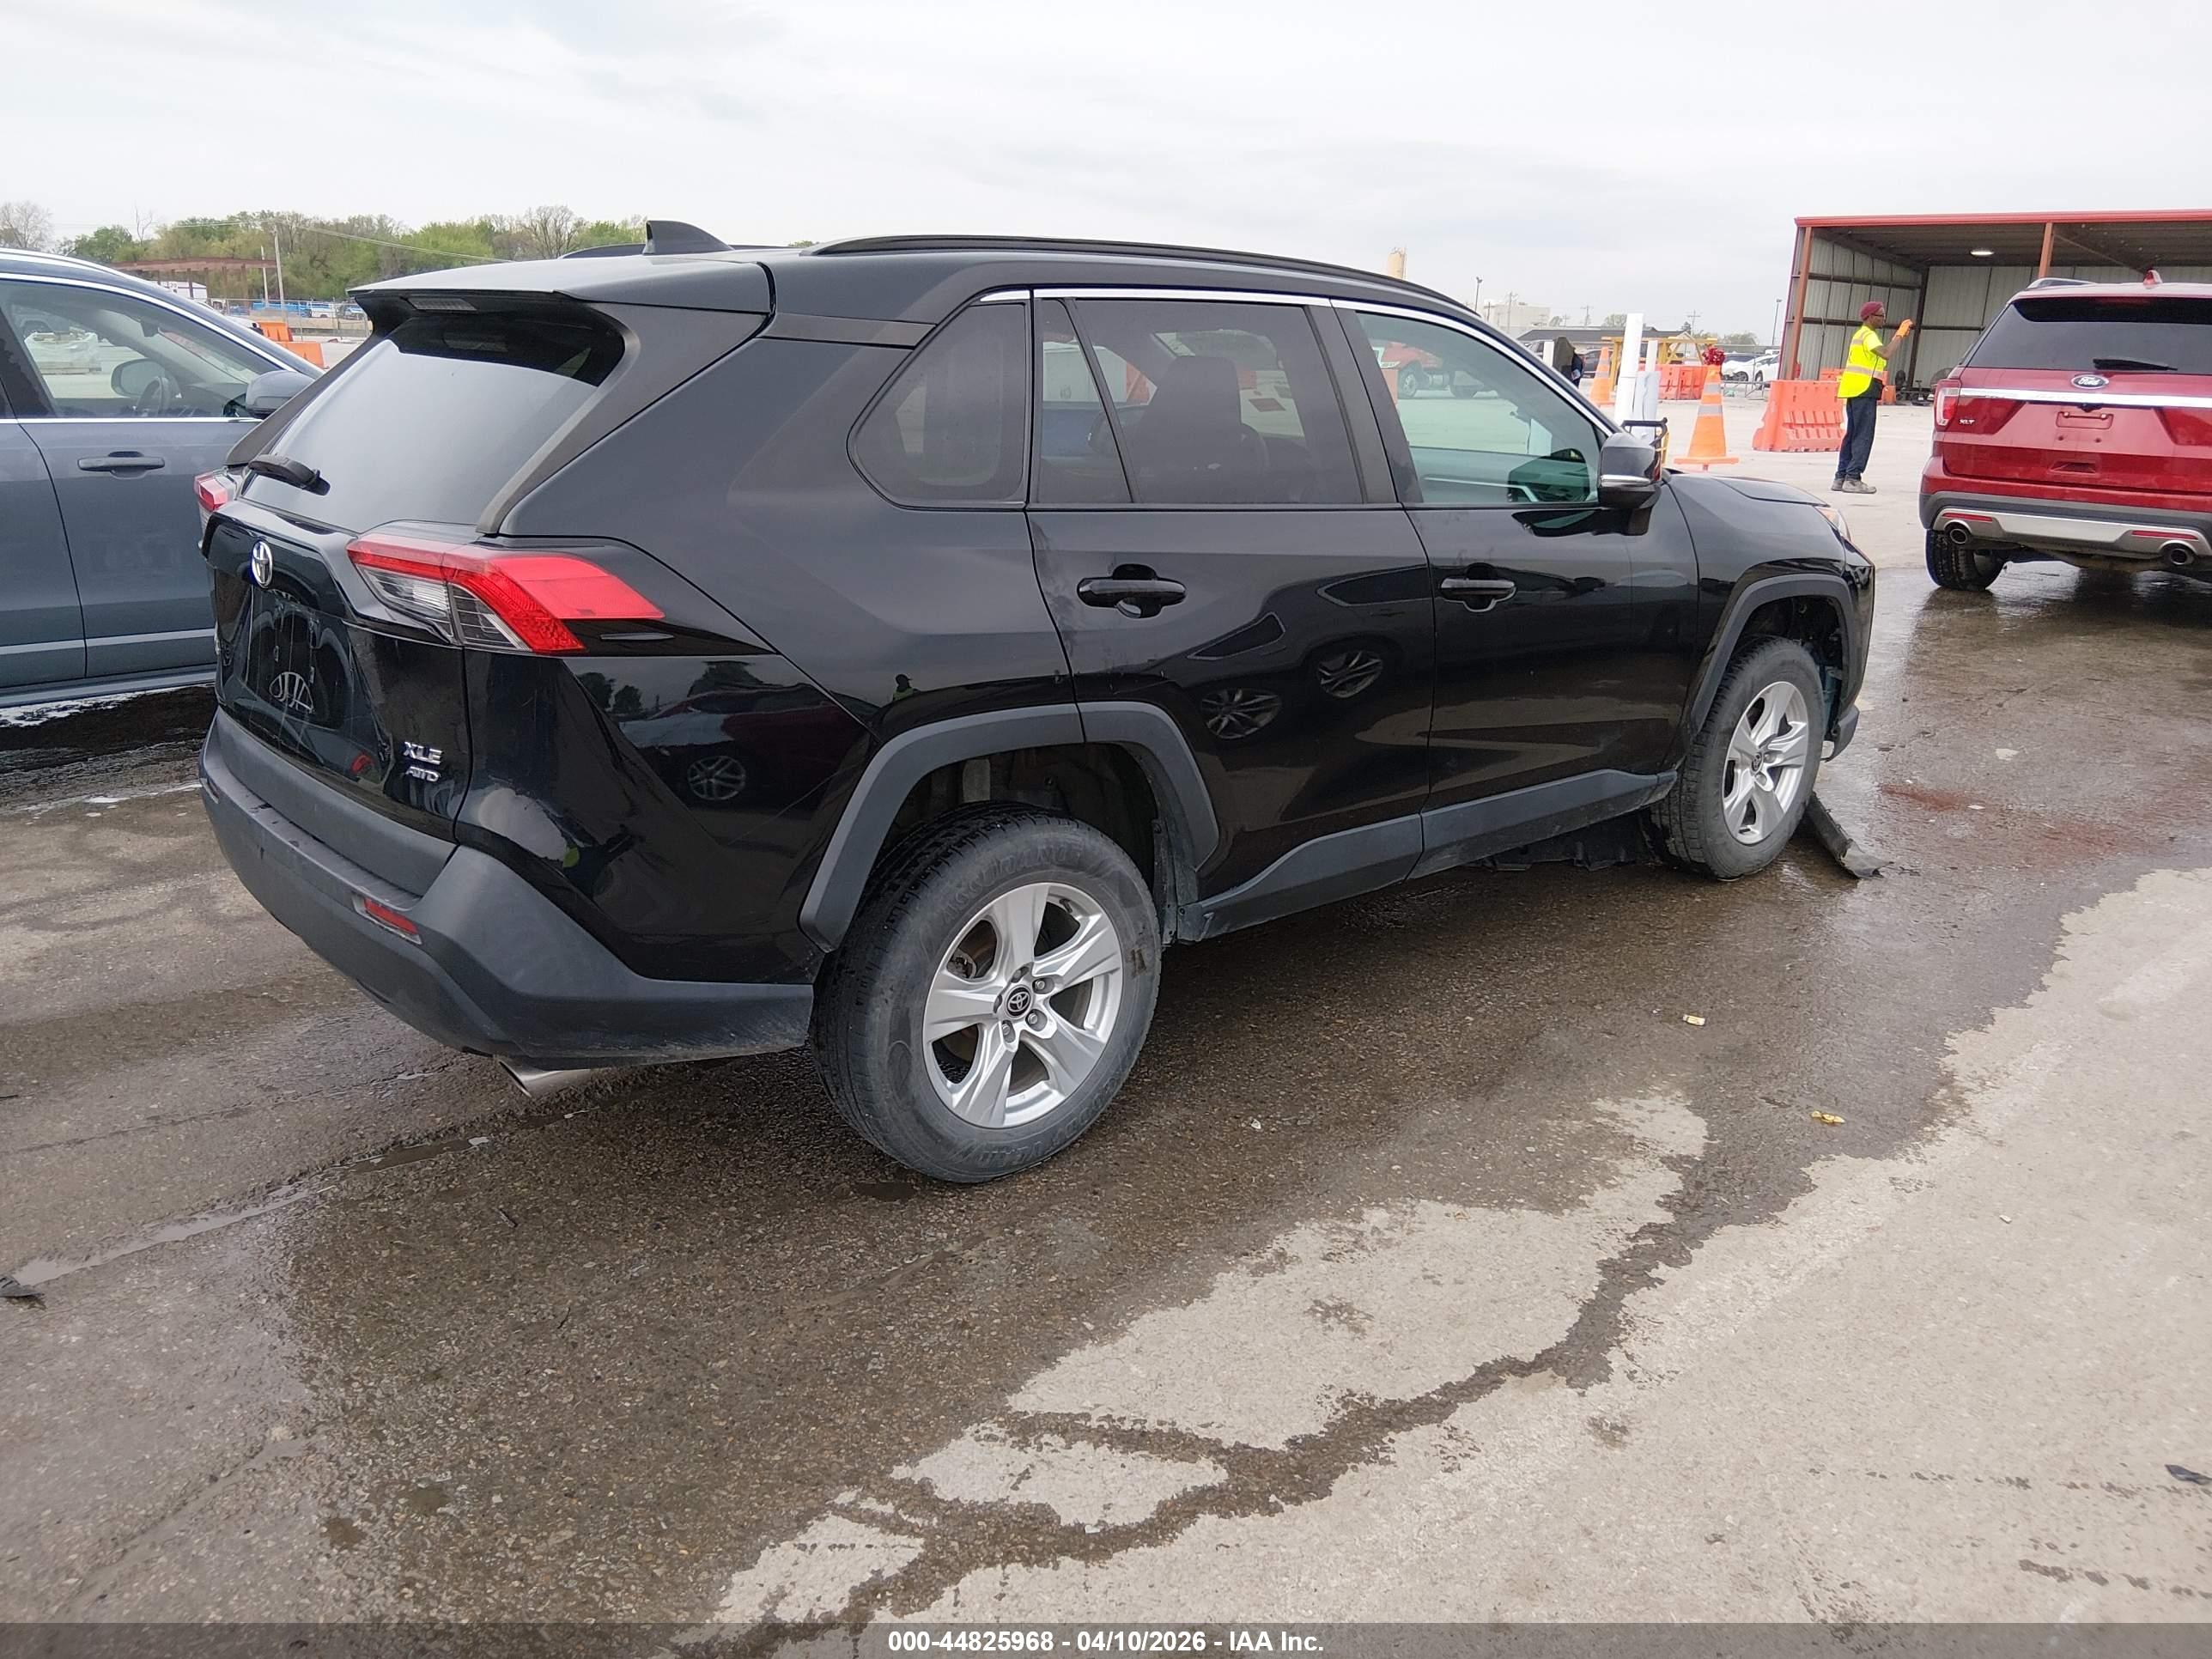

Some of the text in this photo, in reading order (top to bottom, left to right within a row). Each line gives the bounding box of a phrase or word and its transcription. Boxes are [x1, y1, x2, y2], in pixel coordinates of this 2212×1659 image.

[2078, 376, 2100, 386] Ford
[403, 741, 443, 765] XLE
[405, 766, 440, 782] AWD
